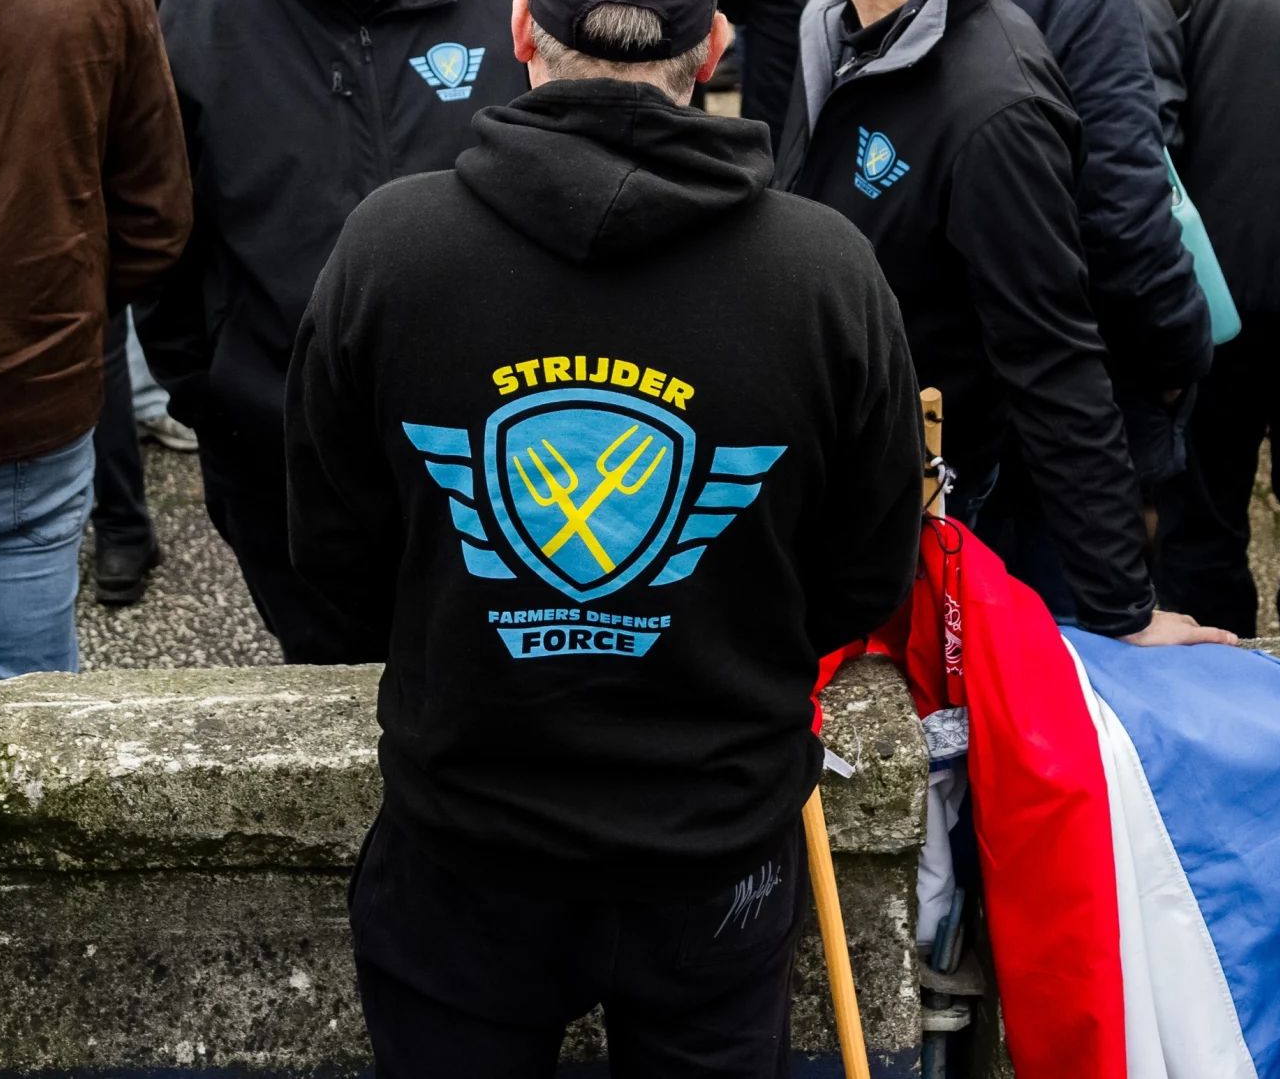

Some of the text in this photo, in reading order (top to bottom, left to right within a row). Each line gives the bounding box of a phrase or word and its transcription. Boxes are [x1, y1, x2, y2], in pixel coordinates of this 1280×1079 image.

[491, 355, 695, 411] STRIJDER
[488, 608, 671, 629] FARMERS DEFENCE
[521, 629, 636, 654] FORCE
